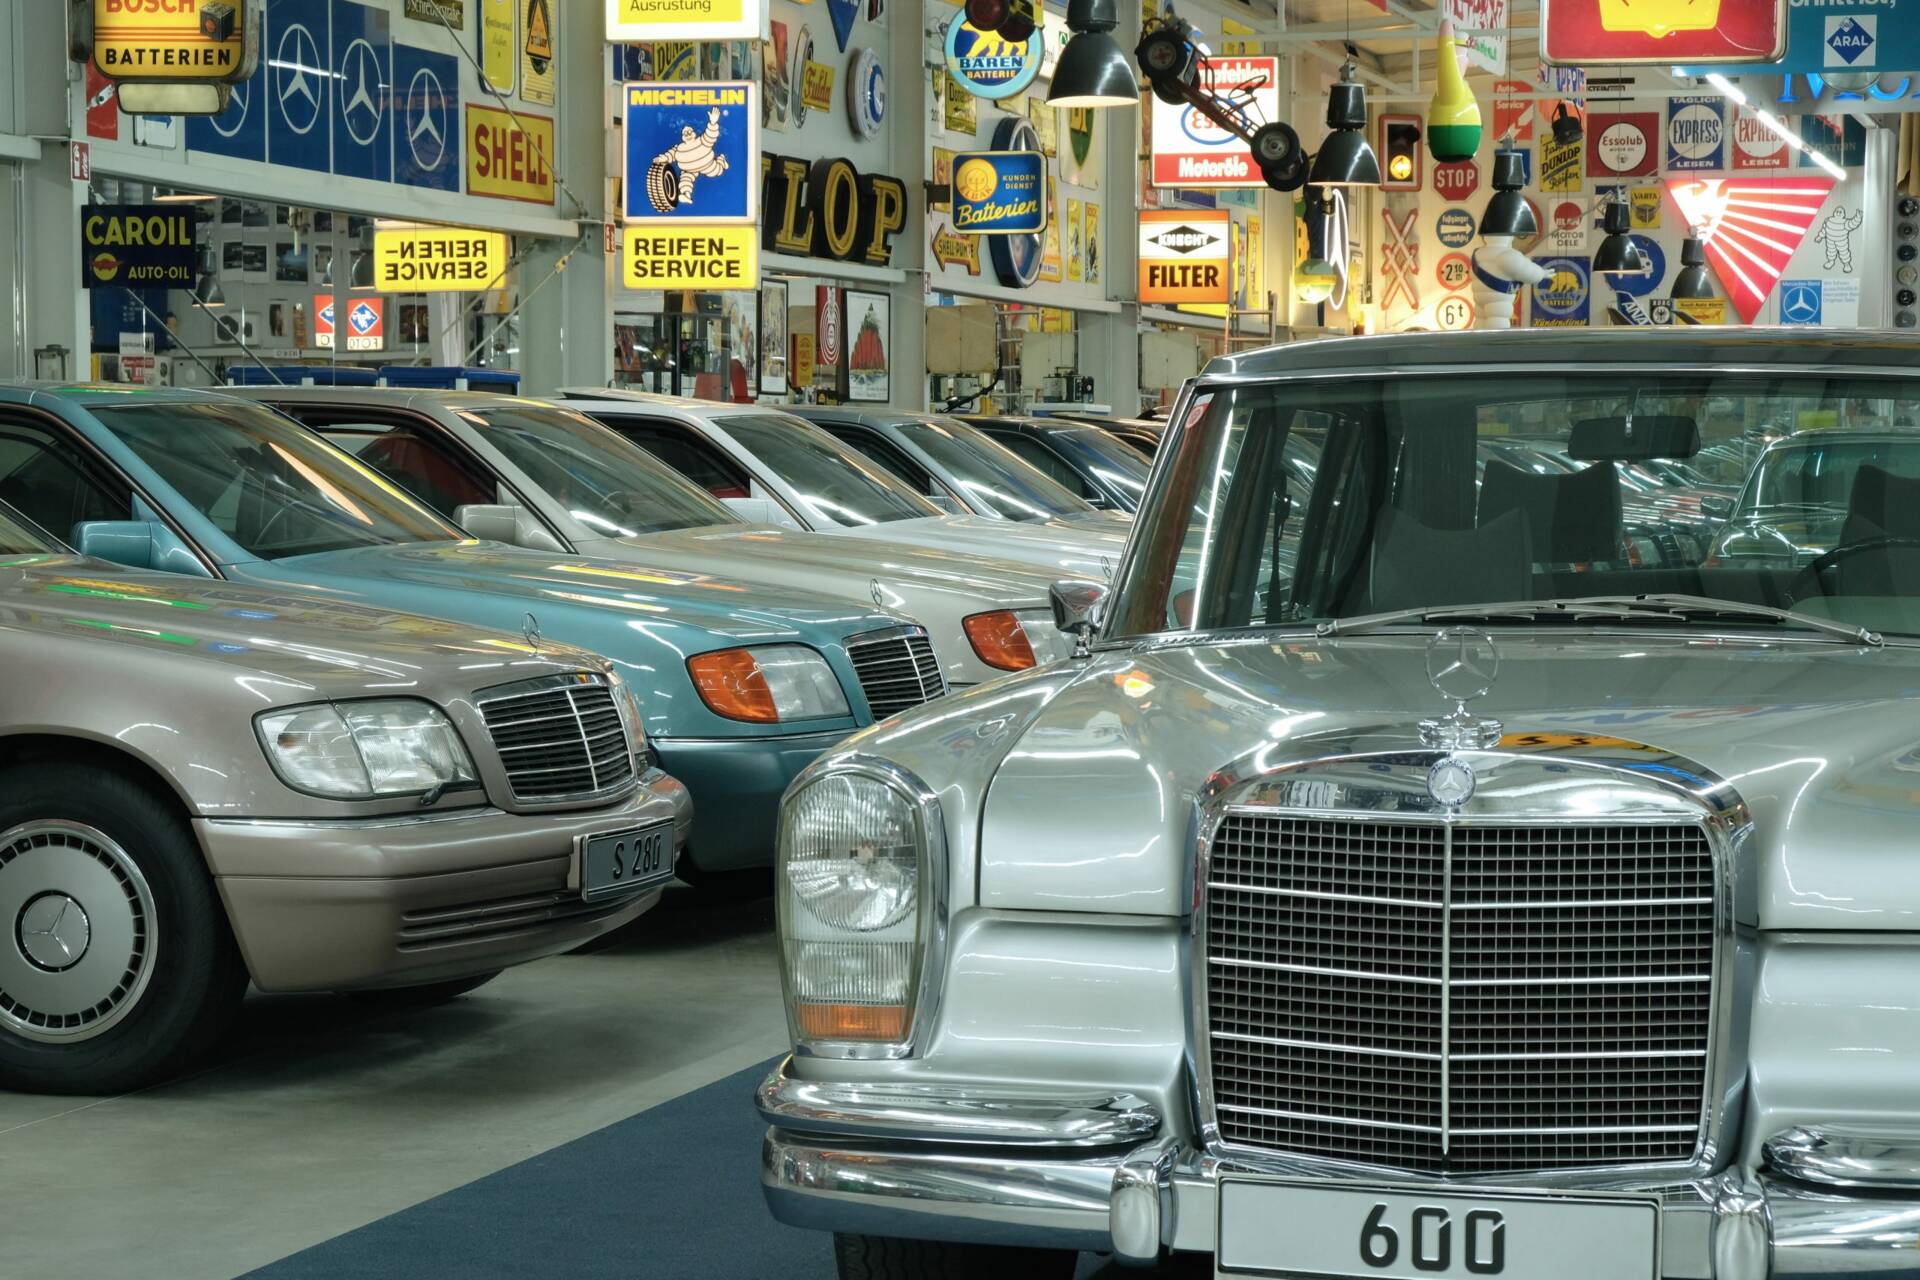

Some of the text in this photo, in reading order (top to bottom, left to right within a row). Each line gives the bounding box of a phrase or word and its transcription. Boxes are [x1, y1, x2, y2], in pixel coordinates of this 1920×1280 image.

[106, 0, 195, 13] BOSCH
[1832, 35, 1869, 47] ARAL
[105, 48, 231, 65] BATTERIEN
[966, 70, 1016, 79] BATTERIE
[1199, 61, 1270, 84] mpfehlen
[630, 89, 745, 105] MICHELIN
[1495, 101, 1525, 110] Service
[1602, 134, 1643, 146] Essolub
[1673, 119, 1719, 144] EXPRESS
[474, 123, 548, 186] SHELL
[1541, 146, 1581, 176] DUNLOP
[1742, 159, 1780, 167] LESEN
[1178, 155, 1249, 178] Motoröle
[1676, 160, 1714, 168] LESEN
[1436, 169, 1475, 188] STOP
[1633, 192, 1658, 200] VARTA
[762, 157, 907, 264] LOP
[957, 197, 1038, 226] Batterien
[85, 215, 191, 246] CAROIL
[1551, 231, 1584, 239] MOTOR
[634, 238, 739, 256] REIFEN-
[1157, 233, 1209, 246] KNECHT
[1557, 239, 1580, 247] OELE
[127, 266, 190, 280] AUTO-OIL
[633, 259, 740, 278] SERVICE
[1149, 265, 1219, 288] FILTER
[1445, 264, 1453, 281] 2
[1445, 304, 1464, 325] 6 t
[612, 832, 661, 879] S 280
[1359, 1202, 1506, 1275] 600
